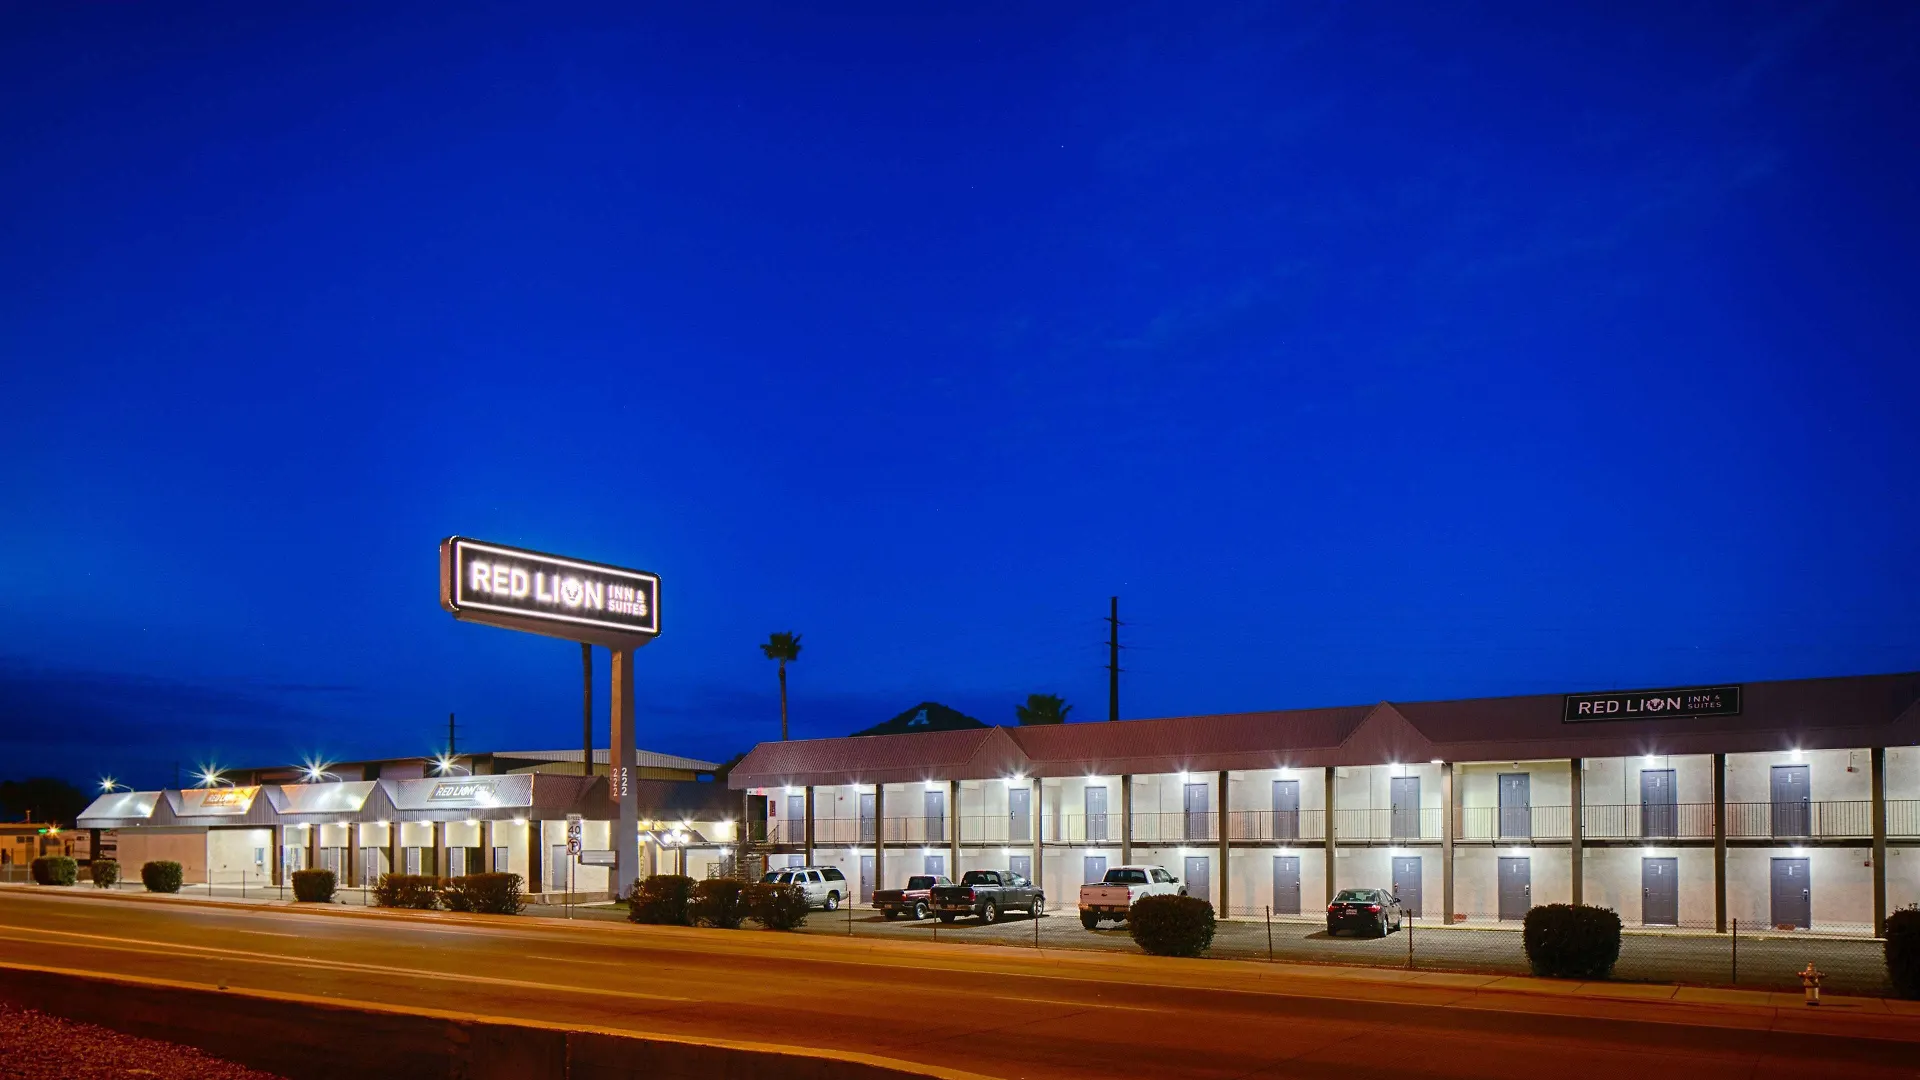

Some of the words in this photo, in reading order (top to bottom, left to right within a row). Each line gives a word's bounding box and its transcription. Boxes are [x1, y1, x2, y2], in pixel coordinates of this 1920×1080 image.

[470, 560, 530, 598] RED
[535, 572, 604, 610] LION
[609, 585, 633, 600] INN
[637, 590, 646, 602] &
[608, 601, 647, 617] SUITES
[1578, 700, 1619, 715] RED
[1626, 697, 1681, 712] LION
[1687, 702, 1722, 710] SUITES
[1688, 695, 1710, 703] INN
[907, 709, 930, 726] A
[436, 787, 454, 796] RED
[568, 825, 580, 835] 40
